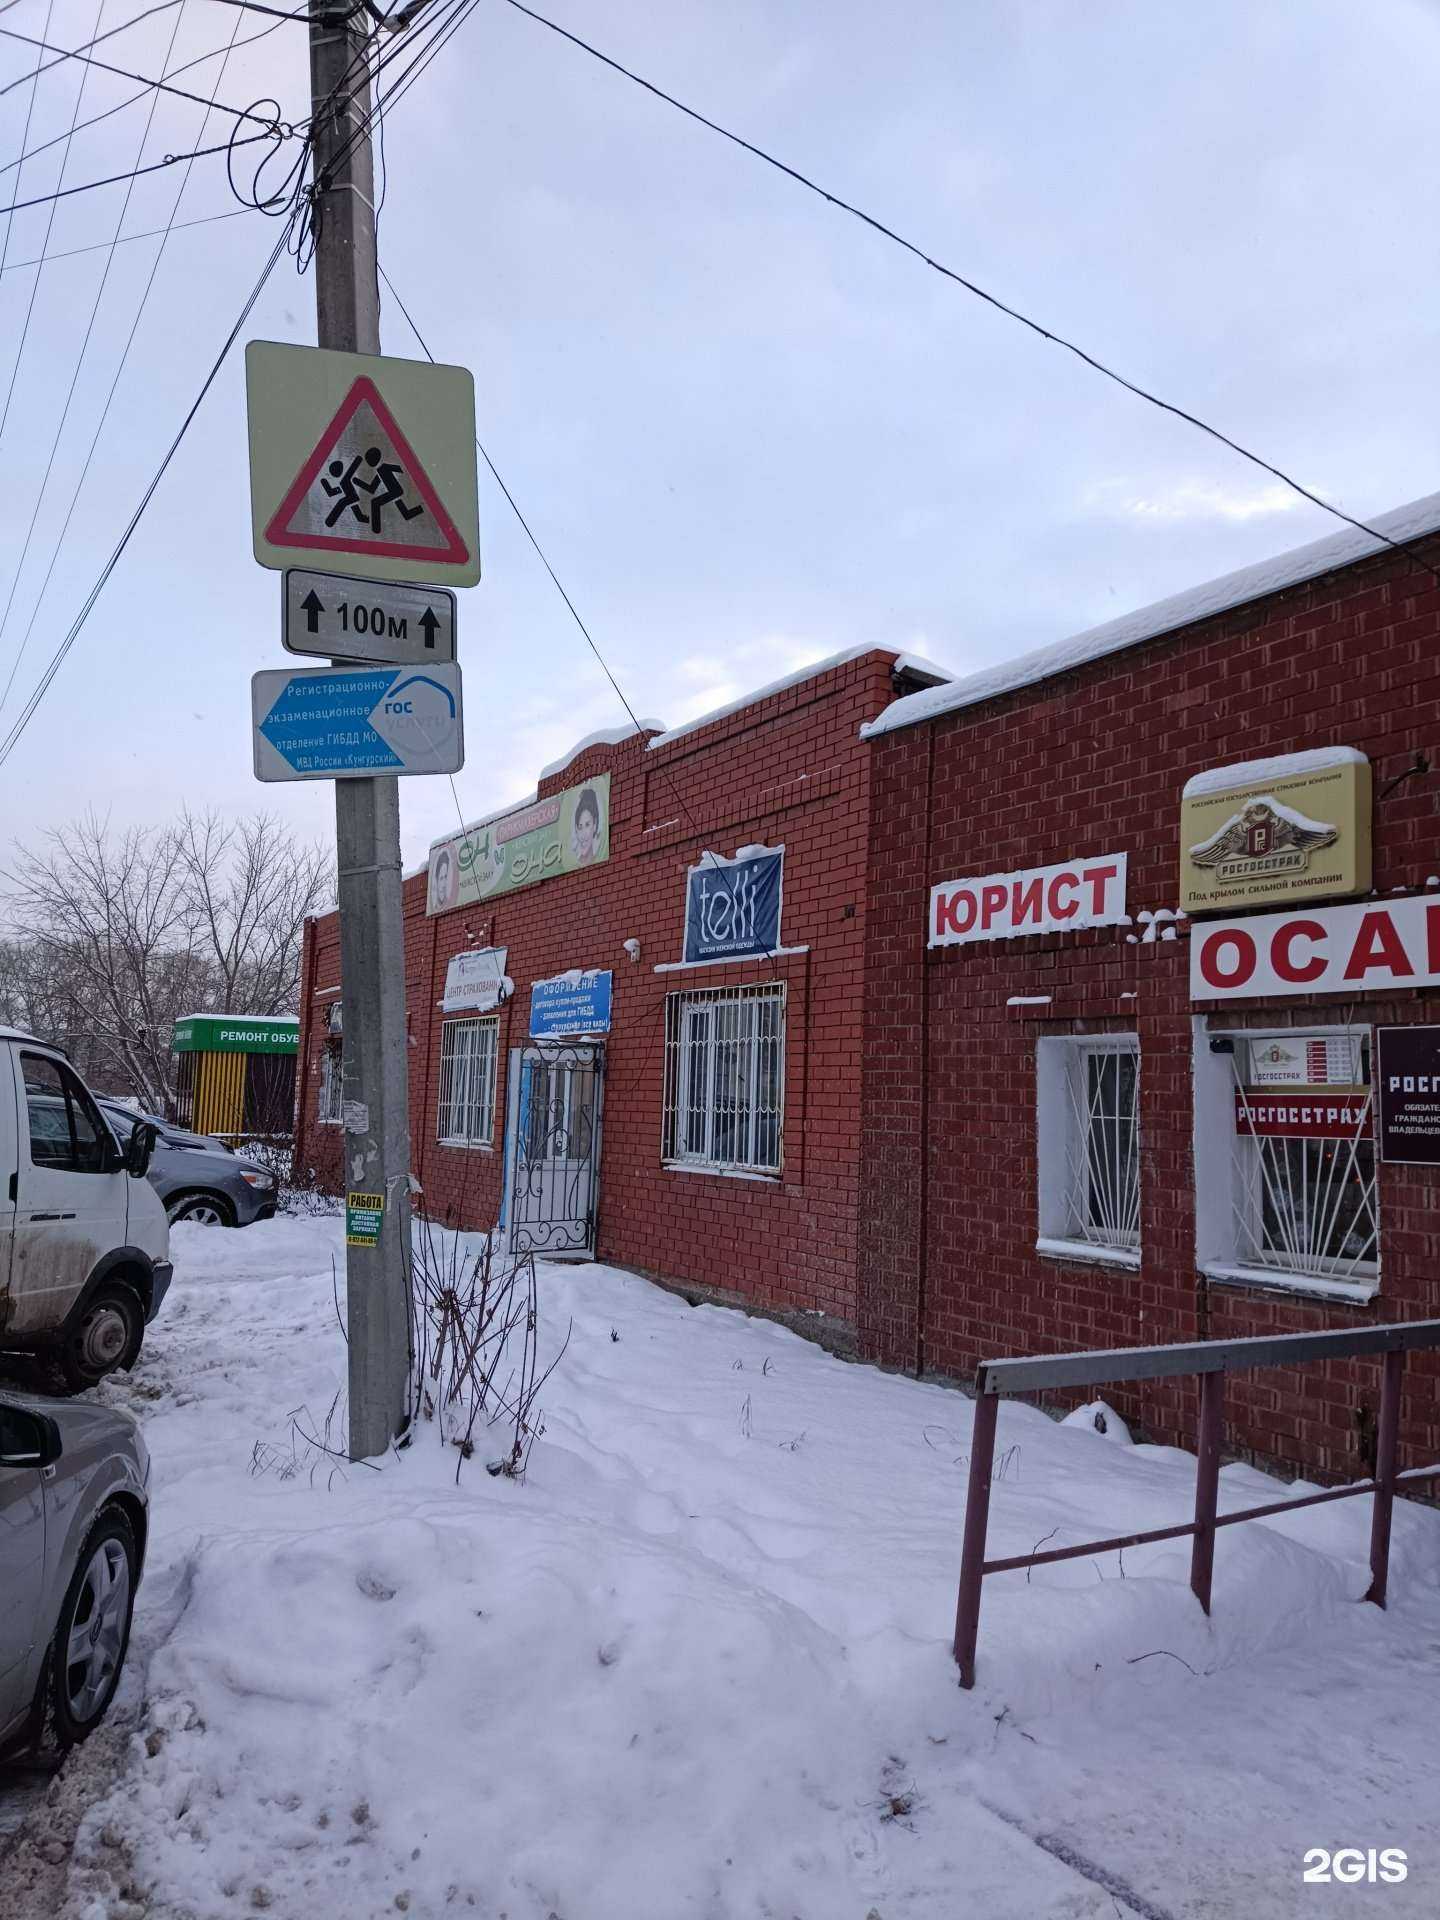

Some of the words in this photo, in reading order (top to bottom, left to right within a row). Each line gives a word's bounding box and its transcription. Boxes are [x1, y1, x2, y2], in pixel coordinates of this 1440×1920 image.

[337, 602, 407, 640] 100м
[287, 681, 390, 697] Регистрационно-
[267, 706, 371, 723] экзаменационное
[276, 737, 324, 751] отделение
[327, 732, 360, 747] ГИБДД
[363, 731, 377, 743] МО
[297, 755, 313, 769] МВД
[314, 754, 341, 768] России
[1309, 772, 1342, 785] КОМПАНИЯ
[1222, 854, 1301, 876] РОСГОССТРАХ
[1188, 891, 1207, 902] Под
[1209, 886, 1245, 901] крылом
[1248, 880, 1289, 894] сильной
[1291, 874, 1343, 889] компании
[936, 865, 1117, 936] ЮРИСТ
[220, 1030, 268, 1043] РЕМОНТ
[1238, 1106, 1368, 1125] РОСГОССТРАХ
[350, 1194, 381, 1209] РАБОТА
